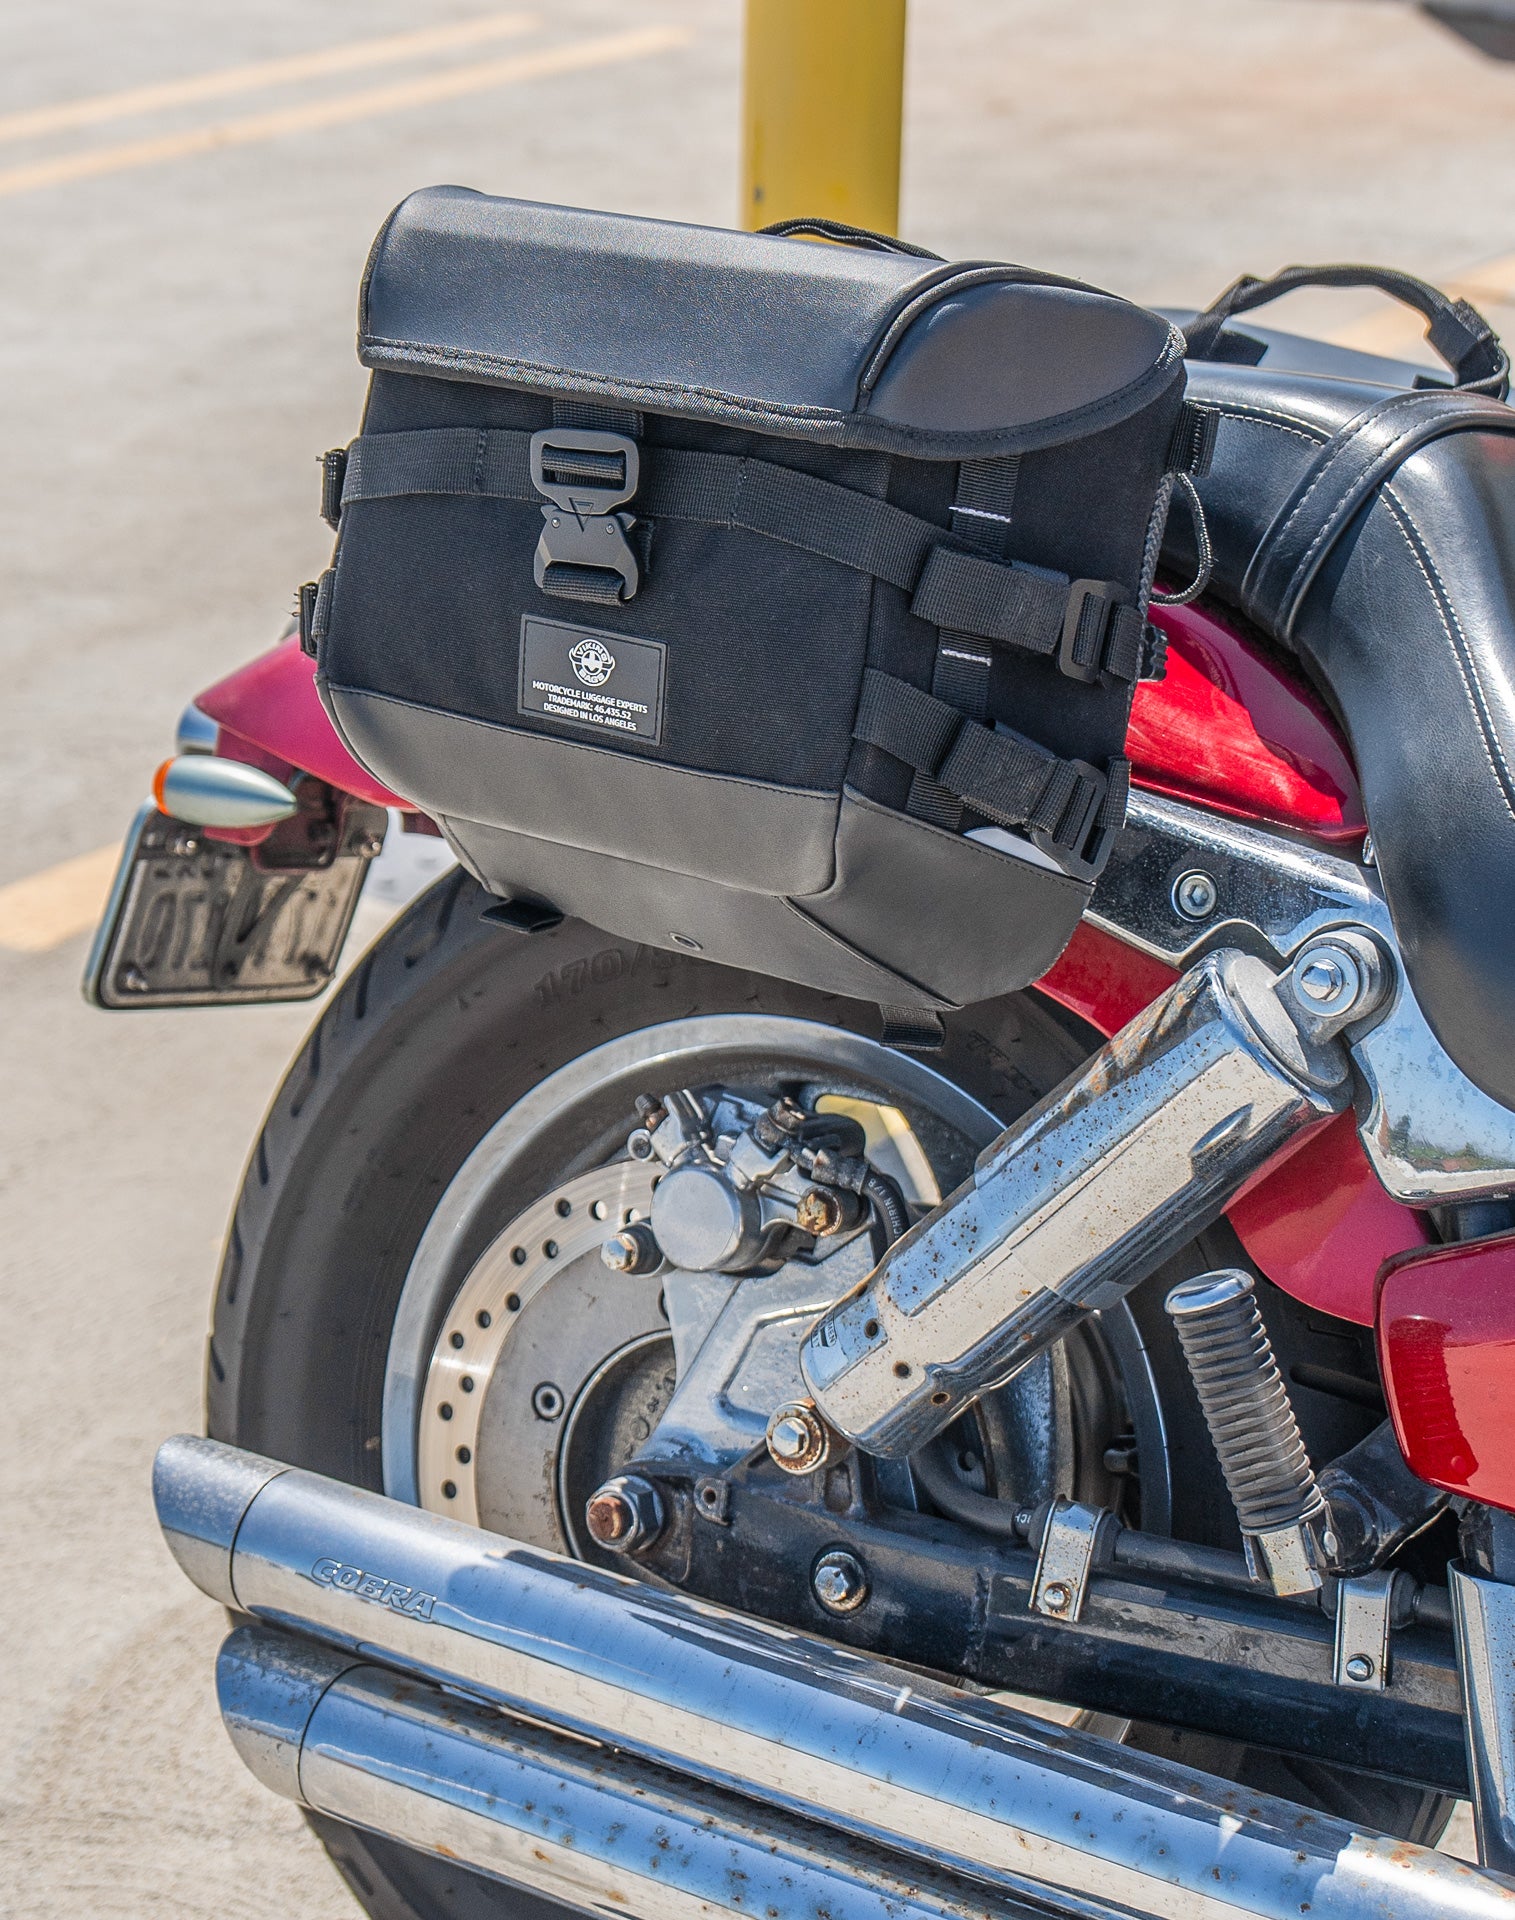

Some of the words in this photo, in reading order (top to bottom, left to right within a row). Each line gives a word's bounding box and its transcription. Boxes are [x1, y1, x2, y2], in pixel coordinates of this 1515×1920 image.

[576, 642, 608, 662] VIKING
[578, 669, 605, 683] BAGS
[532, 681, 581, 698] MOTORCYCLE
[581, 691, 616, 706] LUGGAGE
[616, 700, 648, 714] EXPERTS
[548, 693, 594, 711] TRADEMARK:
[594, 704, 632, 720] 46.435.52
[543, 703, 579, 718] DESIGNED
[579, 710, 588, 720] IN
[588, 713, 604, 724] LOS
[604, 717, 637, 731] ANGELES
[311, 1557, 437, 1619] COBRA
